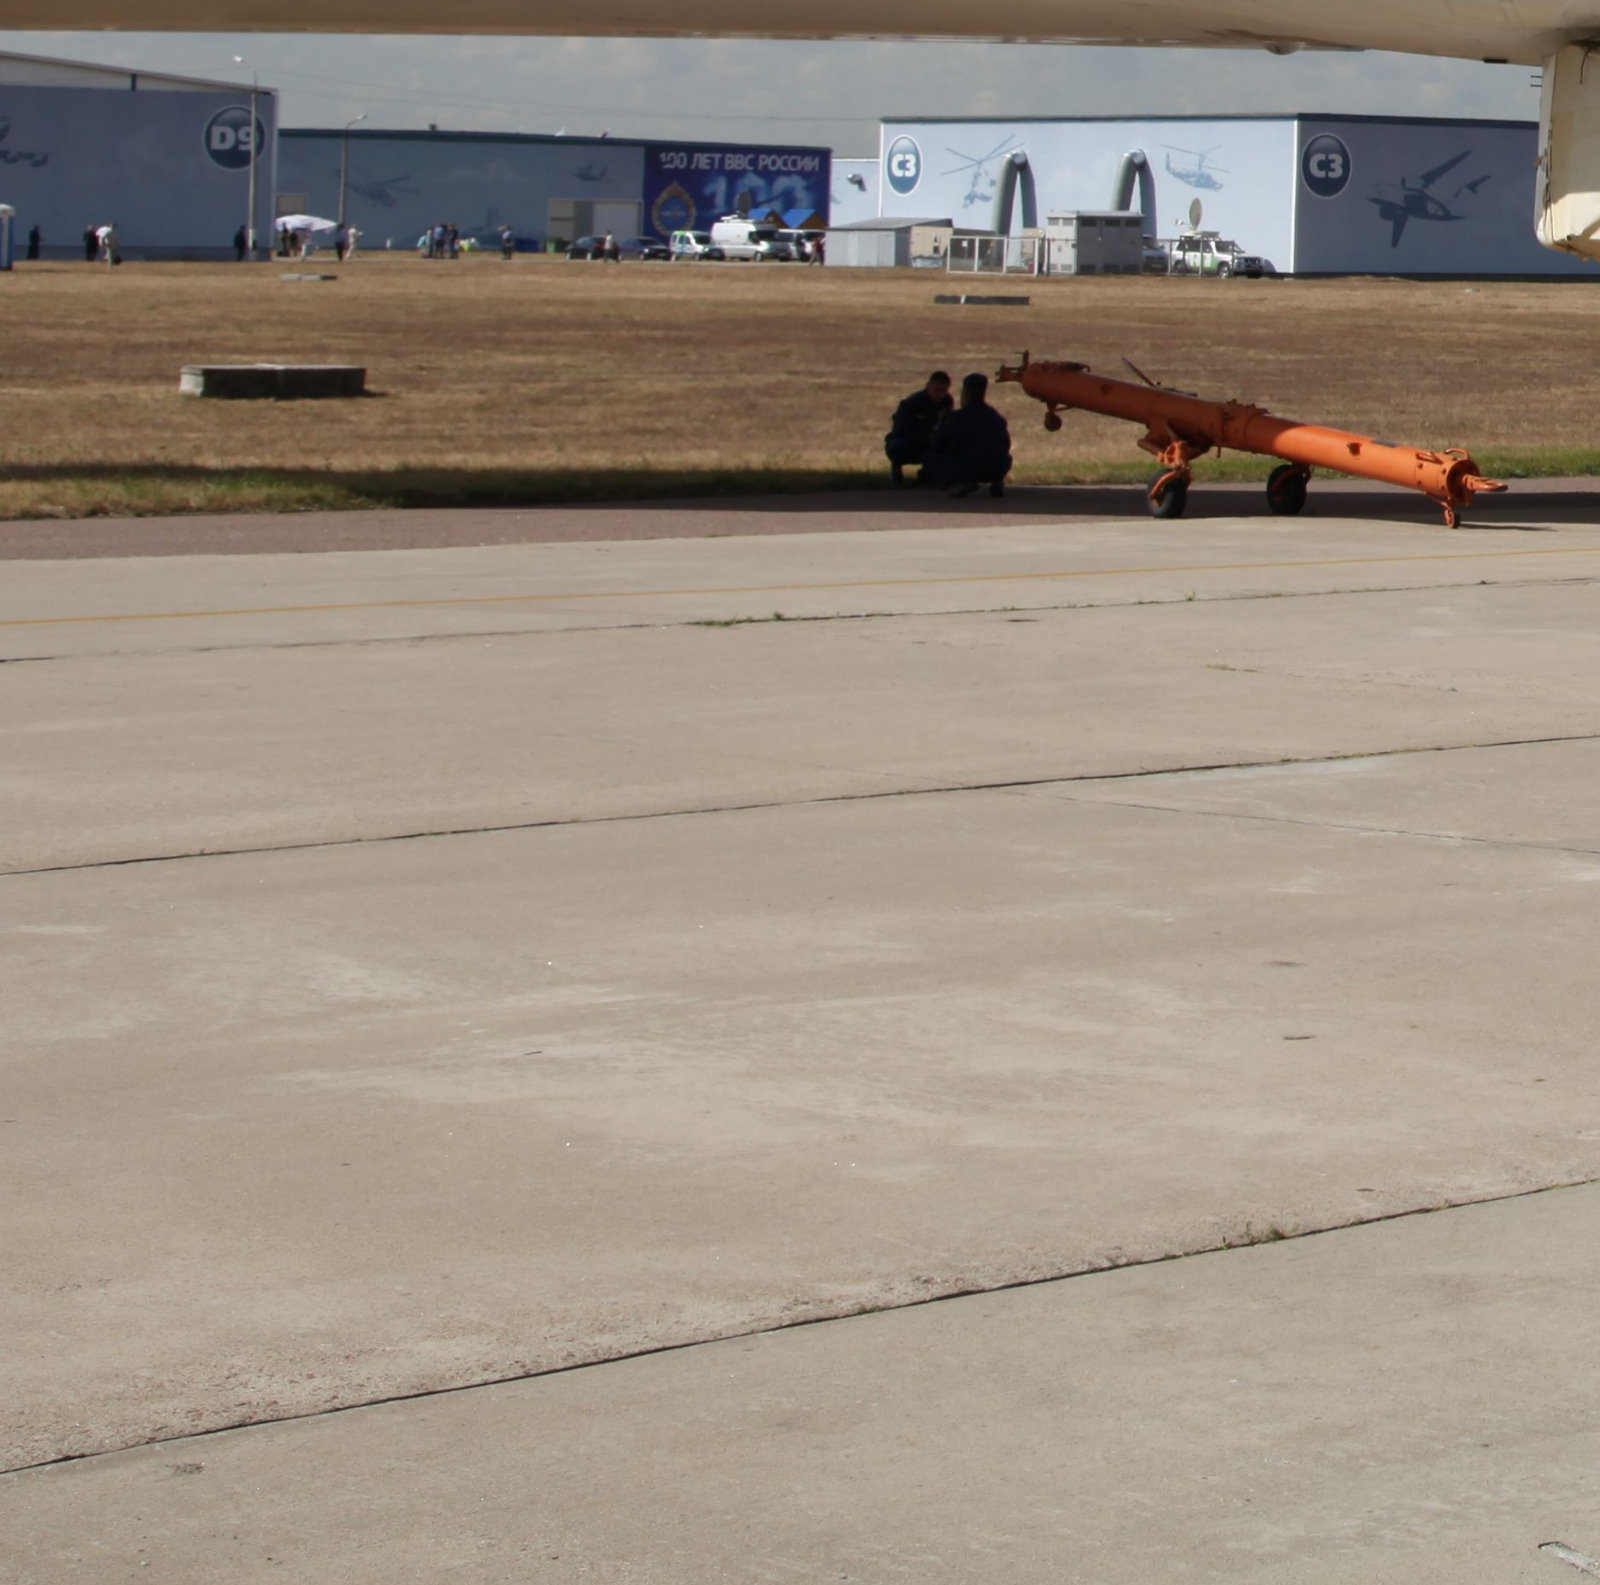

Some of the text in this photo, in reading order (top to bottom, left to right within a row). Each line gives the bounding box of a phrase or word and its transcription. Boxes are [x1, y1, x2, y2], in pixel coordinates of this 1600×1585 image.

[210, 125, 255, 151] D9
[659, 152, 820, 172] 100 ЛЕТ ВВС РОССИИ
